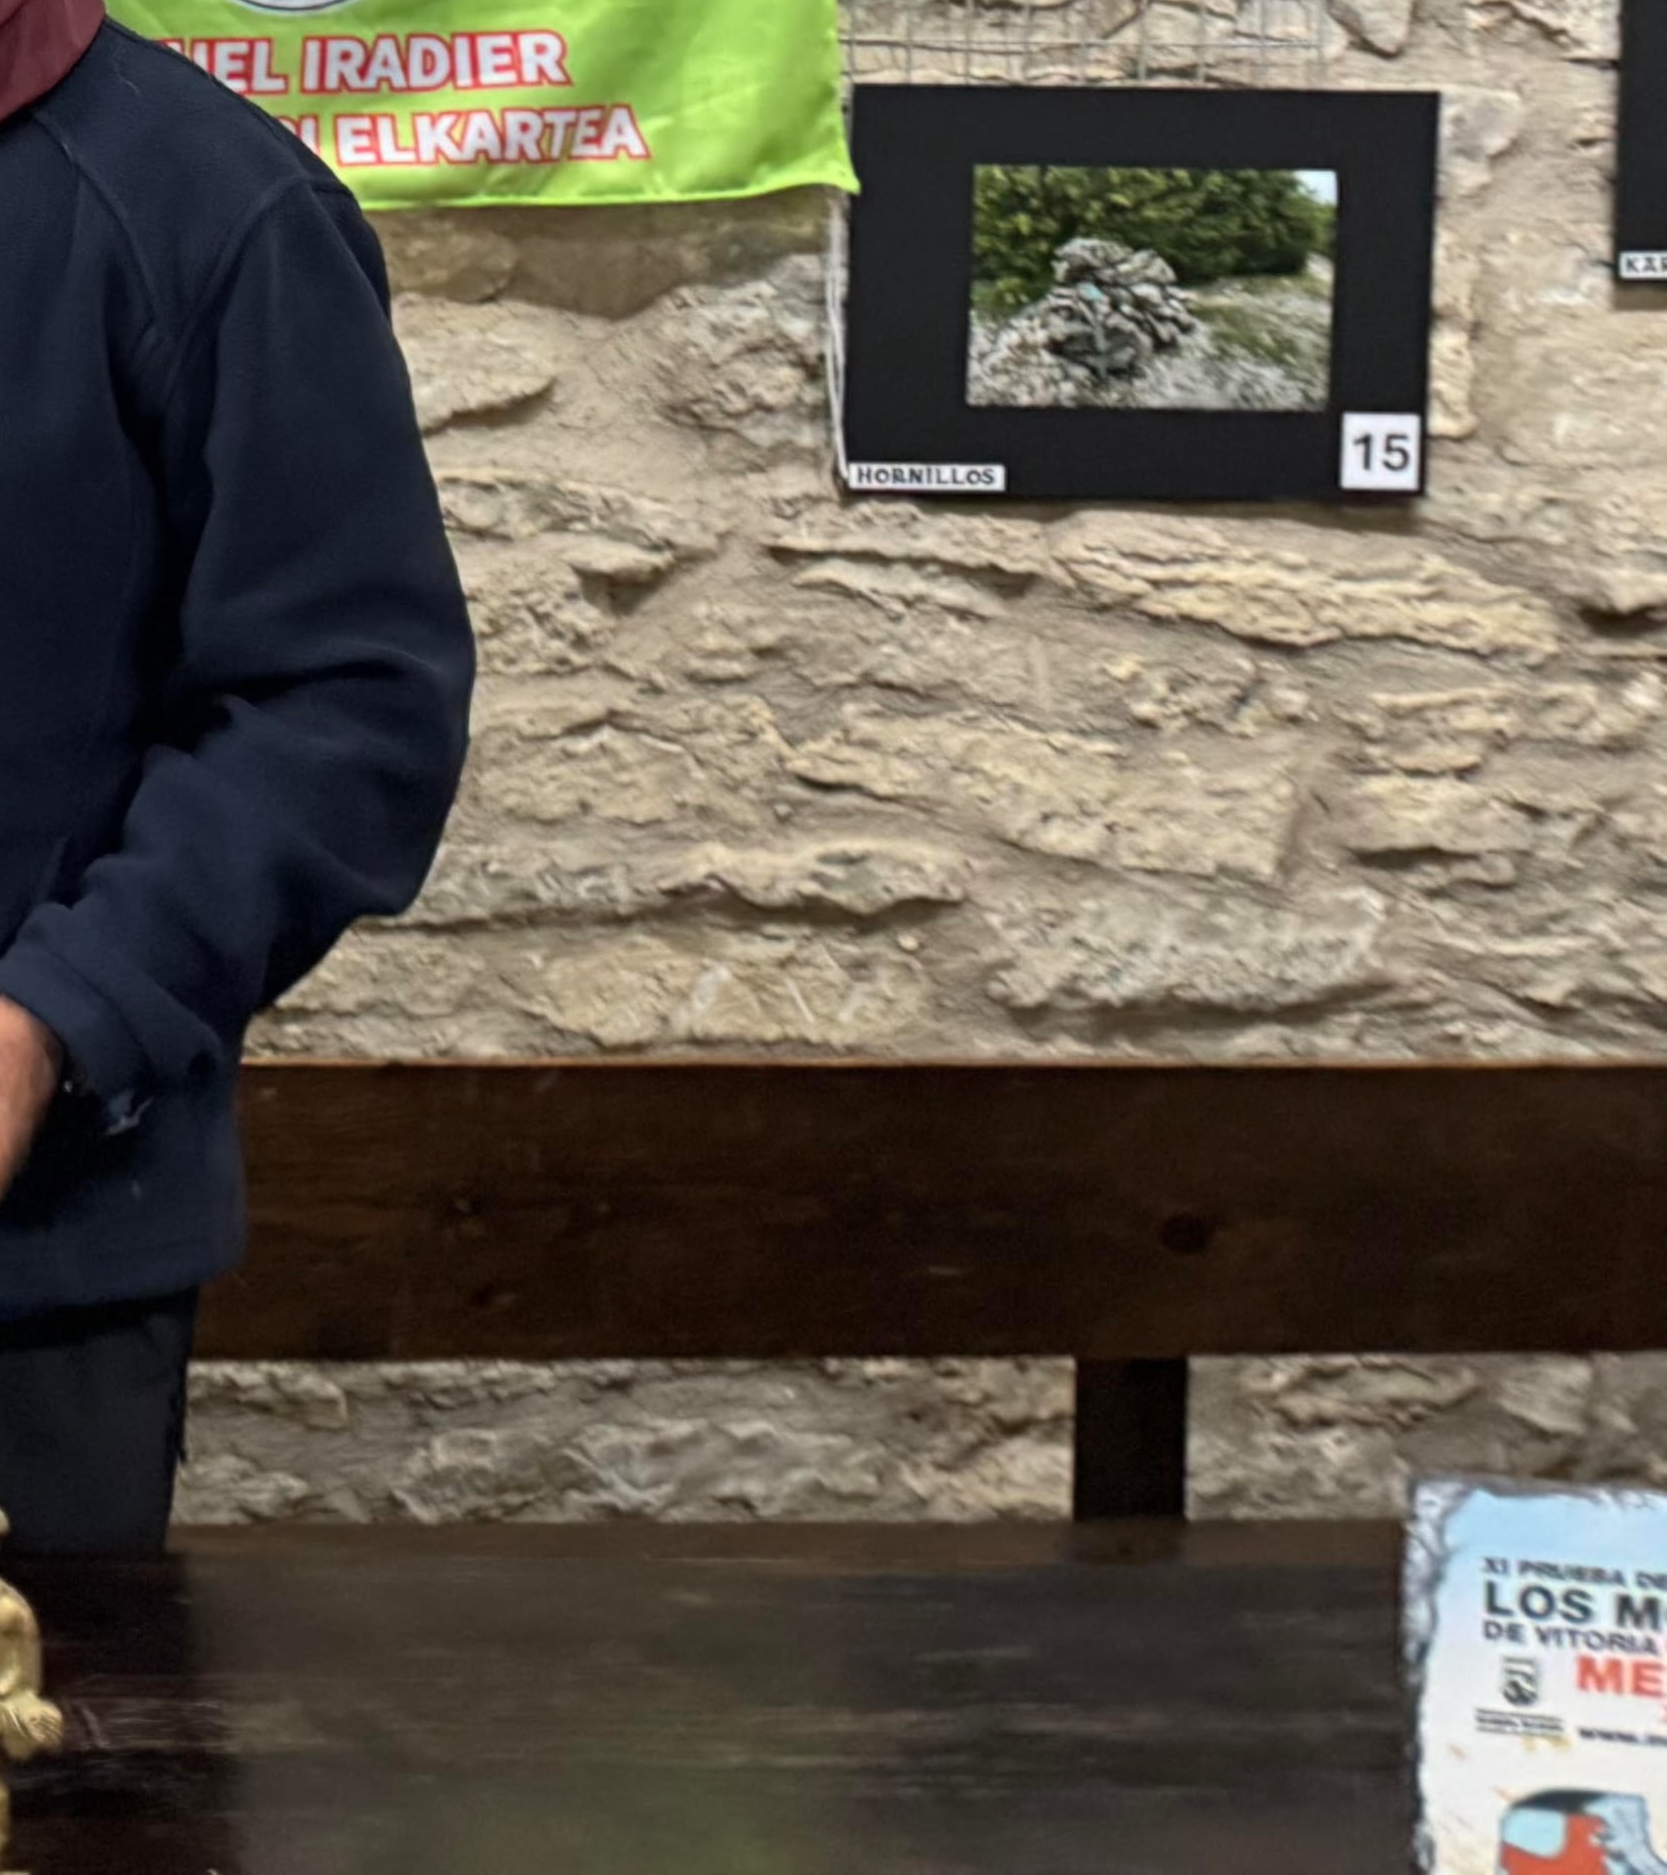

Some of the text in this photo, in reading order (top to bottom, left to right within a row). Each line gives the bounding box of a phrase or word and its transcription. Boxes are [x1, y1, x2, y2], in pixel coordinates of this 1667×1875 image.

[299, 29, 573, 95] IRADIER
[333, 105, 652, 167] ELKARTEA
[1353, 433, 1411, 472] 15
[856, 467, 996, 487] HORNILLOS
[1485, 1580, 1667, 1632] LOS M
[1483, 1620, 1660, 1656] DE VITORIA
[1576, 1653, 1667, 1699] ME
